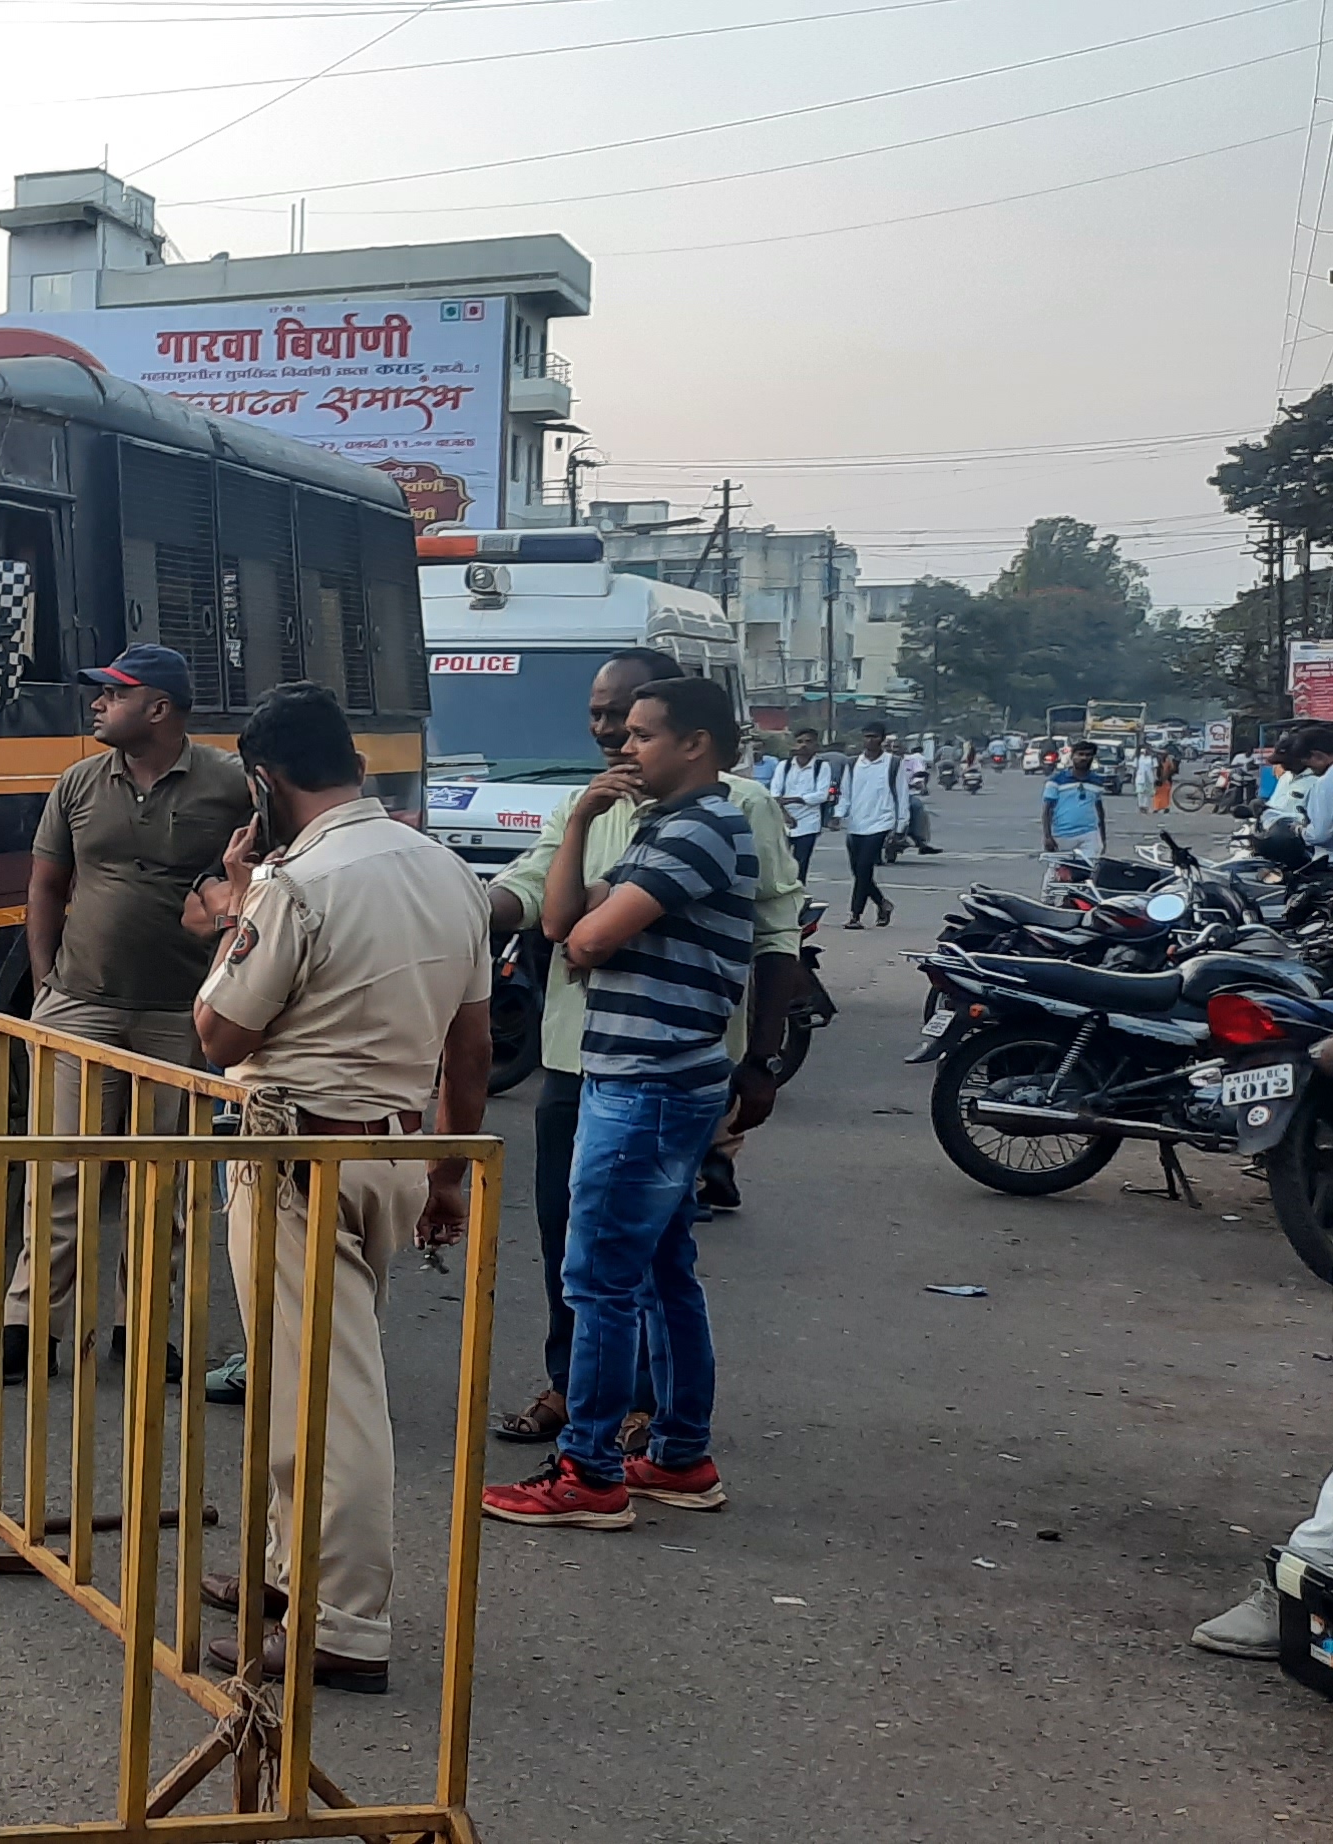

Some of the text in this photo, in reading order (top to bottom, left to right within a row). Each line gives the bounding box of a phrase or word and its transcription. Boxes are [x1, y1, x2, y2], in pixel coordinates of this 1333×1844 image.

[156, 313, 412, 363] गारवा बिर्याणी
[375, 362, 425, 376] कराड
[316, 374, 475, 432] समारंभ
[434, 656, 517, 672] POLICE
[496, 810, 542, 828] पोलीस
[1229, 1078, 1290, 1102] 1012
